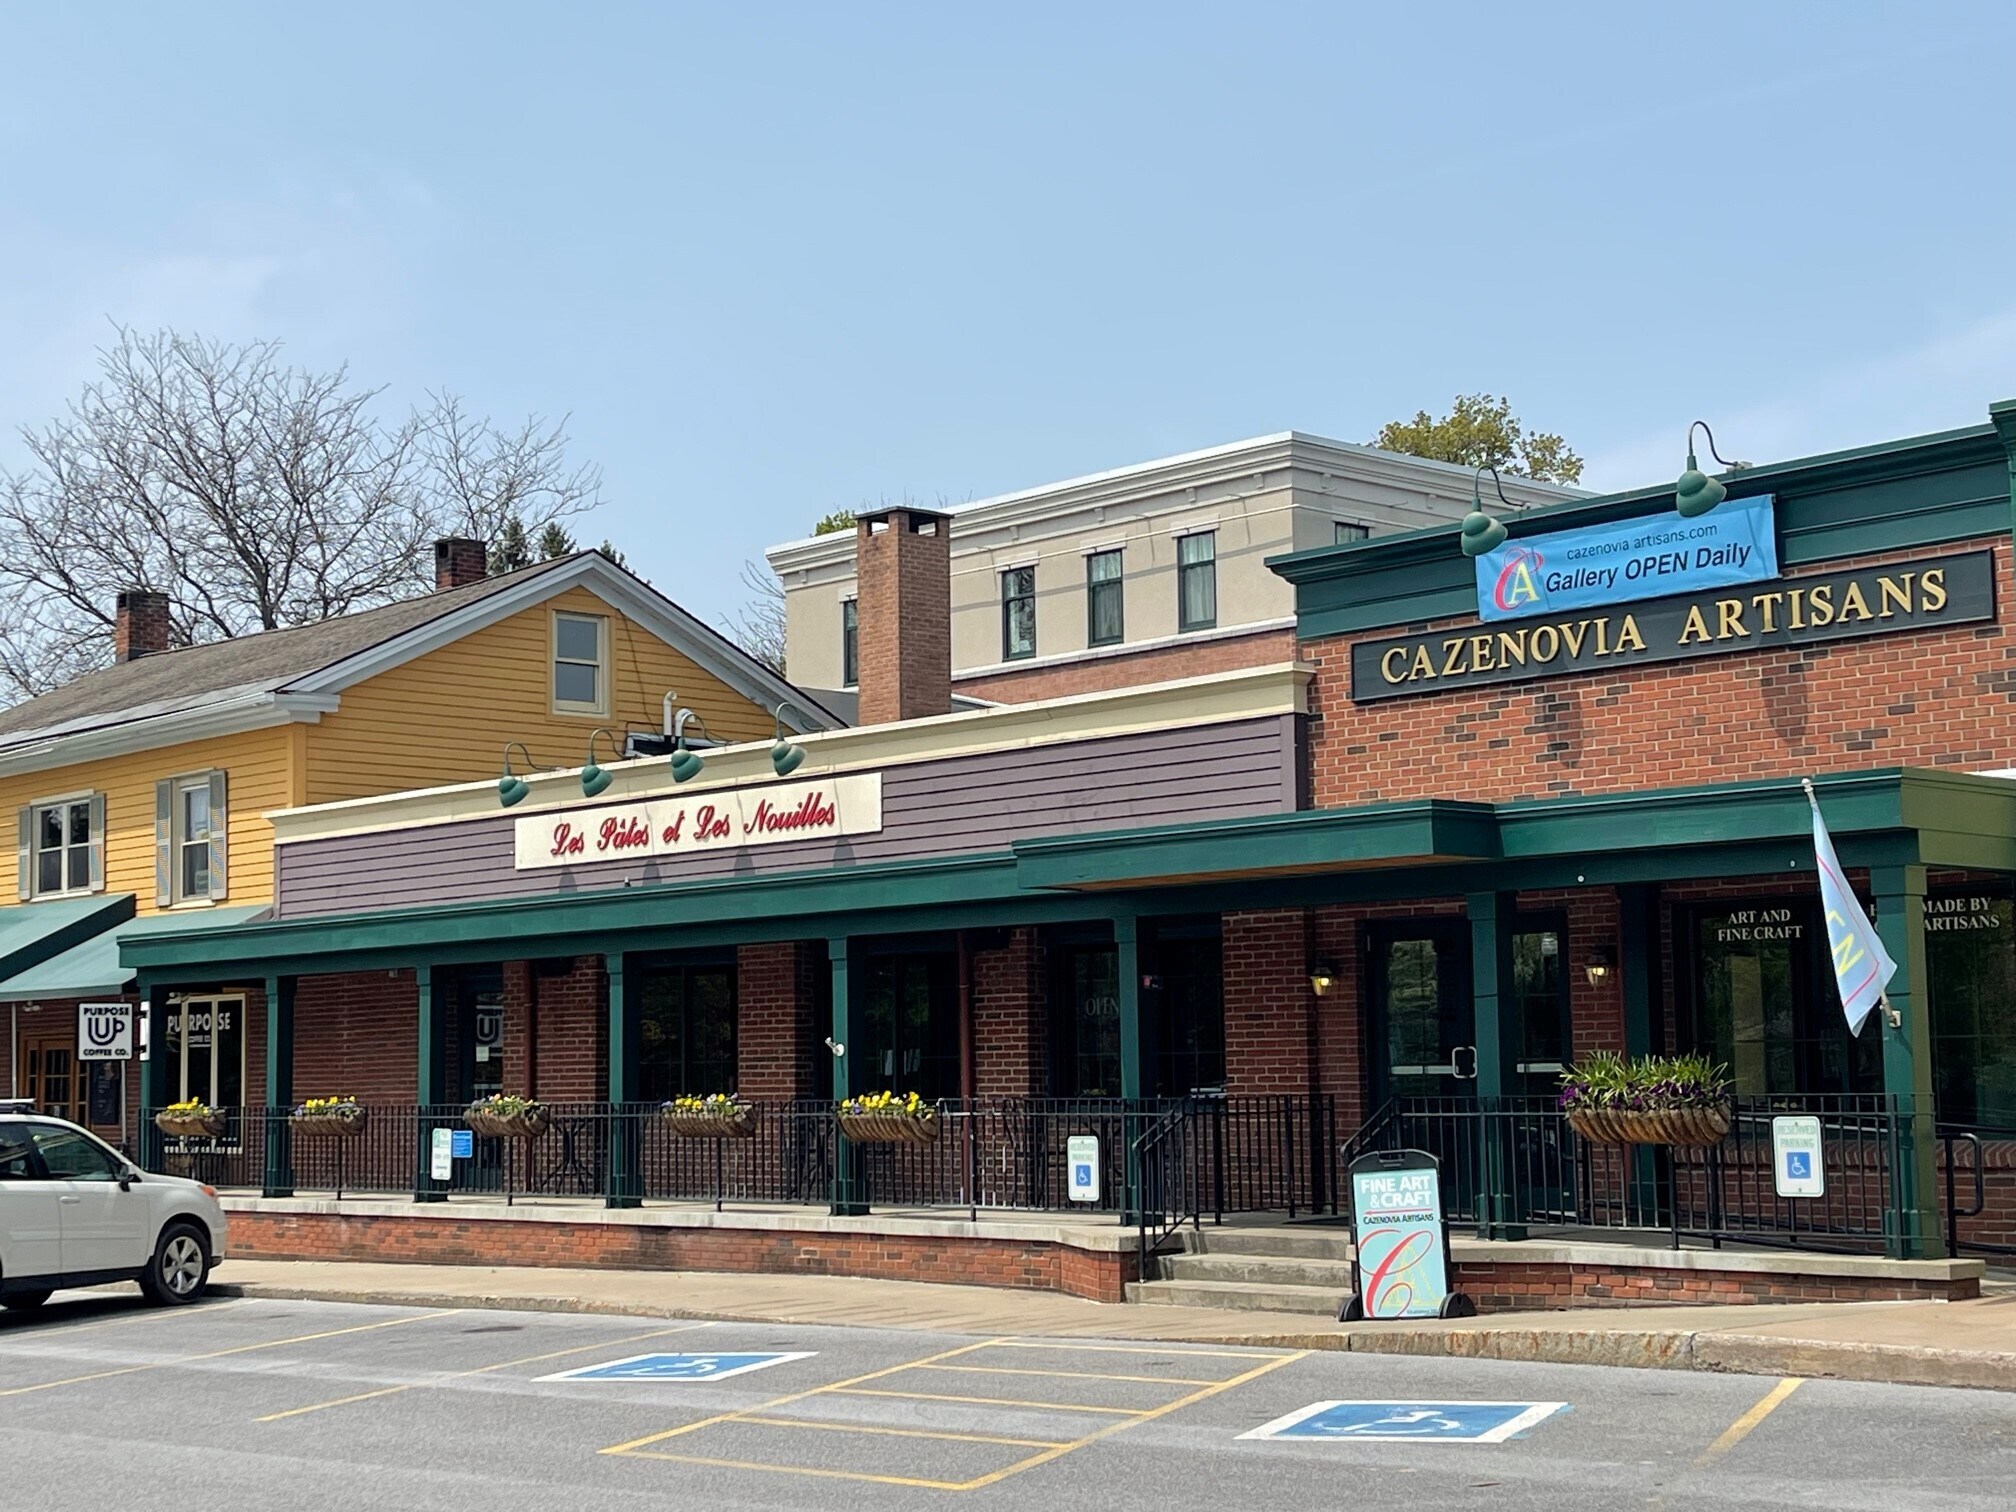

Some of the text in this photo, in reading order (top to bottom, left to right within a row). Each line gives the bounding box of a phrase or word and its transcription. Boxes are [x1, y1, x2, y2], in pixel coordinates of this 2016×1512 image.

[1567, 524, 1718, 561] cazenovia artisans.com
[1546, 542, 1752, 592] Gallery OPEN Daily
[1380, 569, 1947, 684] CAZENOVIA ARTISANS
[550, 792, 836, 855] Les Pâtes et Les Nouilles
[1970, 897, 1991, 911] BY
[1728, 908, 1791, 924] ART AND
[1923, 914, 2000, 931] ARTISANS
[1718, 925, 1803, 942] FINE CRAFT
[84, 1006, 129, 1016] PURPOSE
[1086, 996, 1119, 1016] OPEN
[168, 1012, 231, 1032] PURPOSE
[83, 1048, 112, 1056] COFFEE
[1361, 1175, 1430, 1194] FINE ART
[1363, 1213, 1434, 1225] CAZENOVIA ARTISANS
